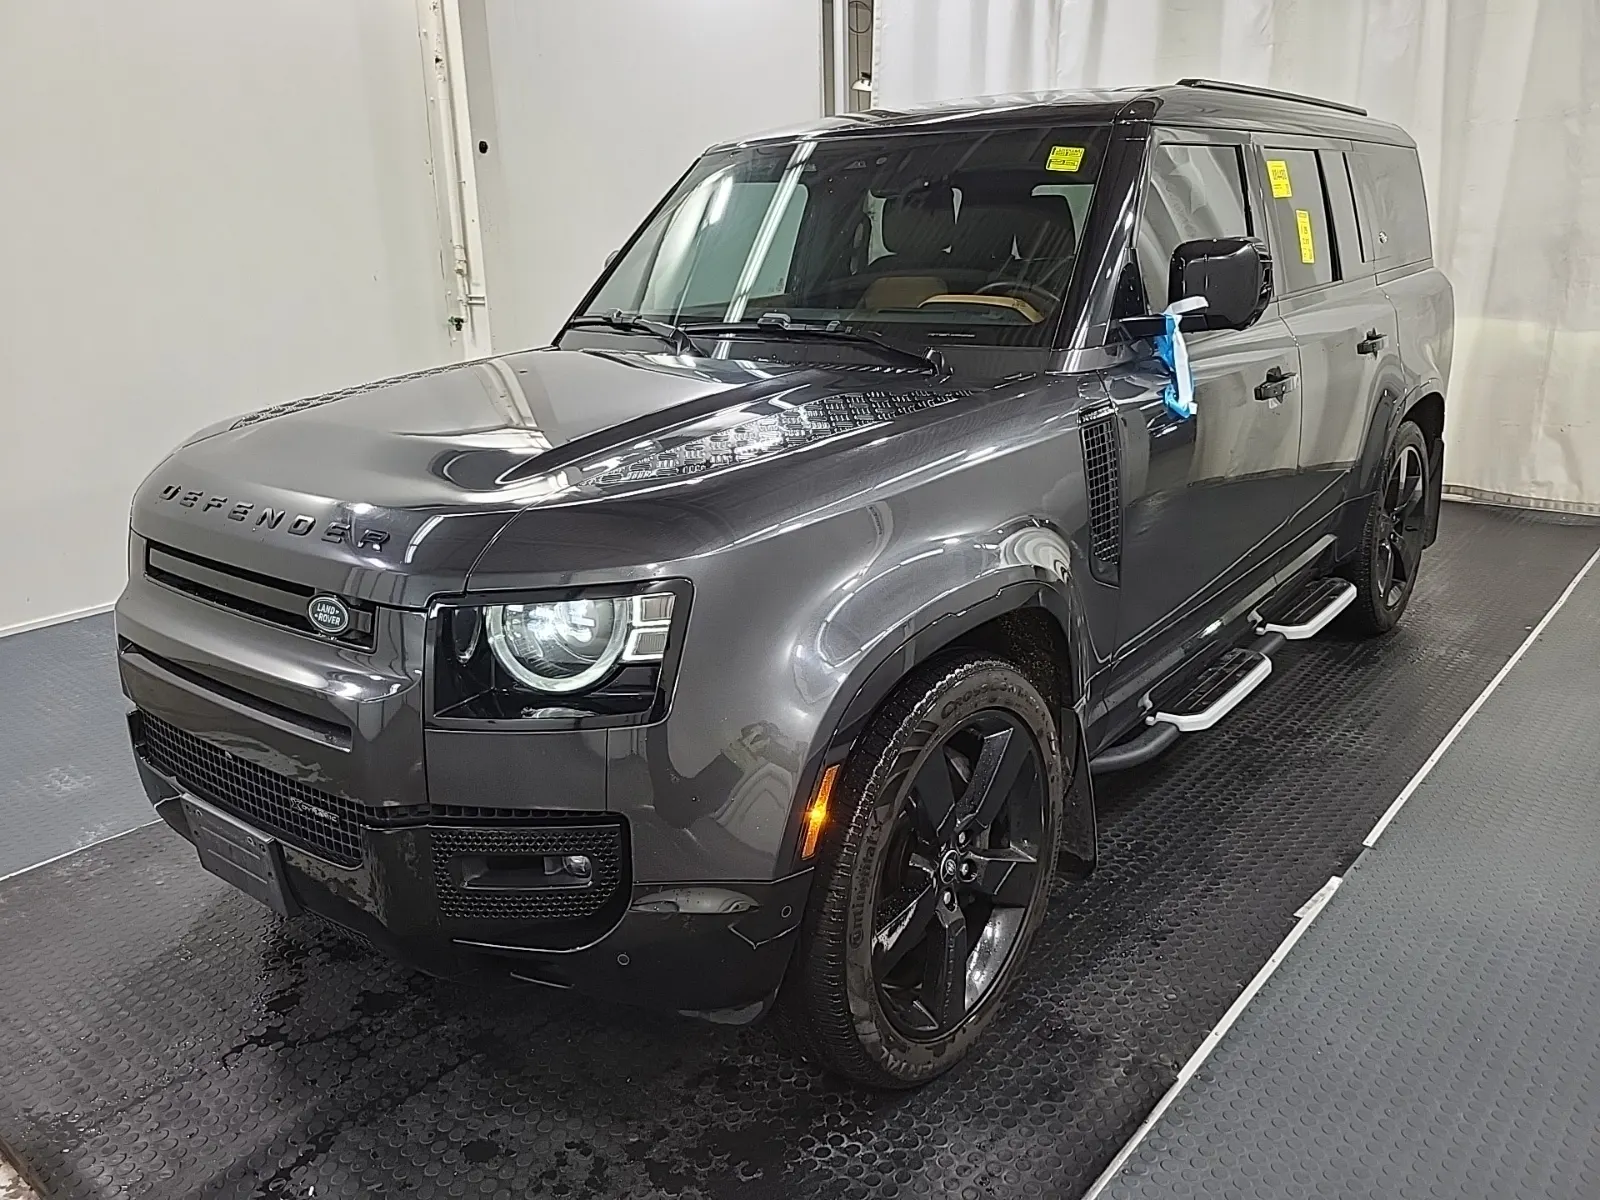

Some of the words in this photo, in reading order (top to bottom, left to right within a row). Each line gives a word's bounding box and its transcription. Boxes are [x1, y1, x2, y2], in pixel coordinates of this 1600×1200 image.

[159, 485, 390, 551] DEFENDER
[317, 602, 336, 615] LAND
[317, 612, 341, 626] ROVER
